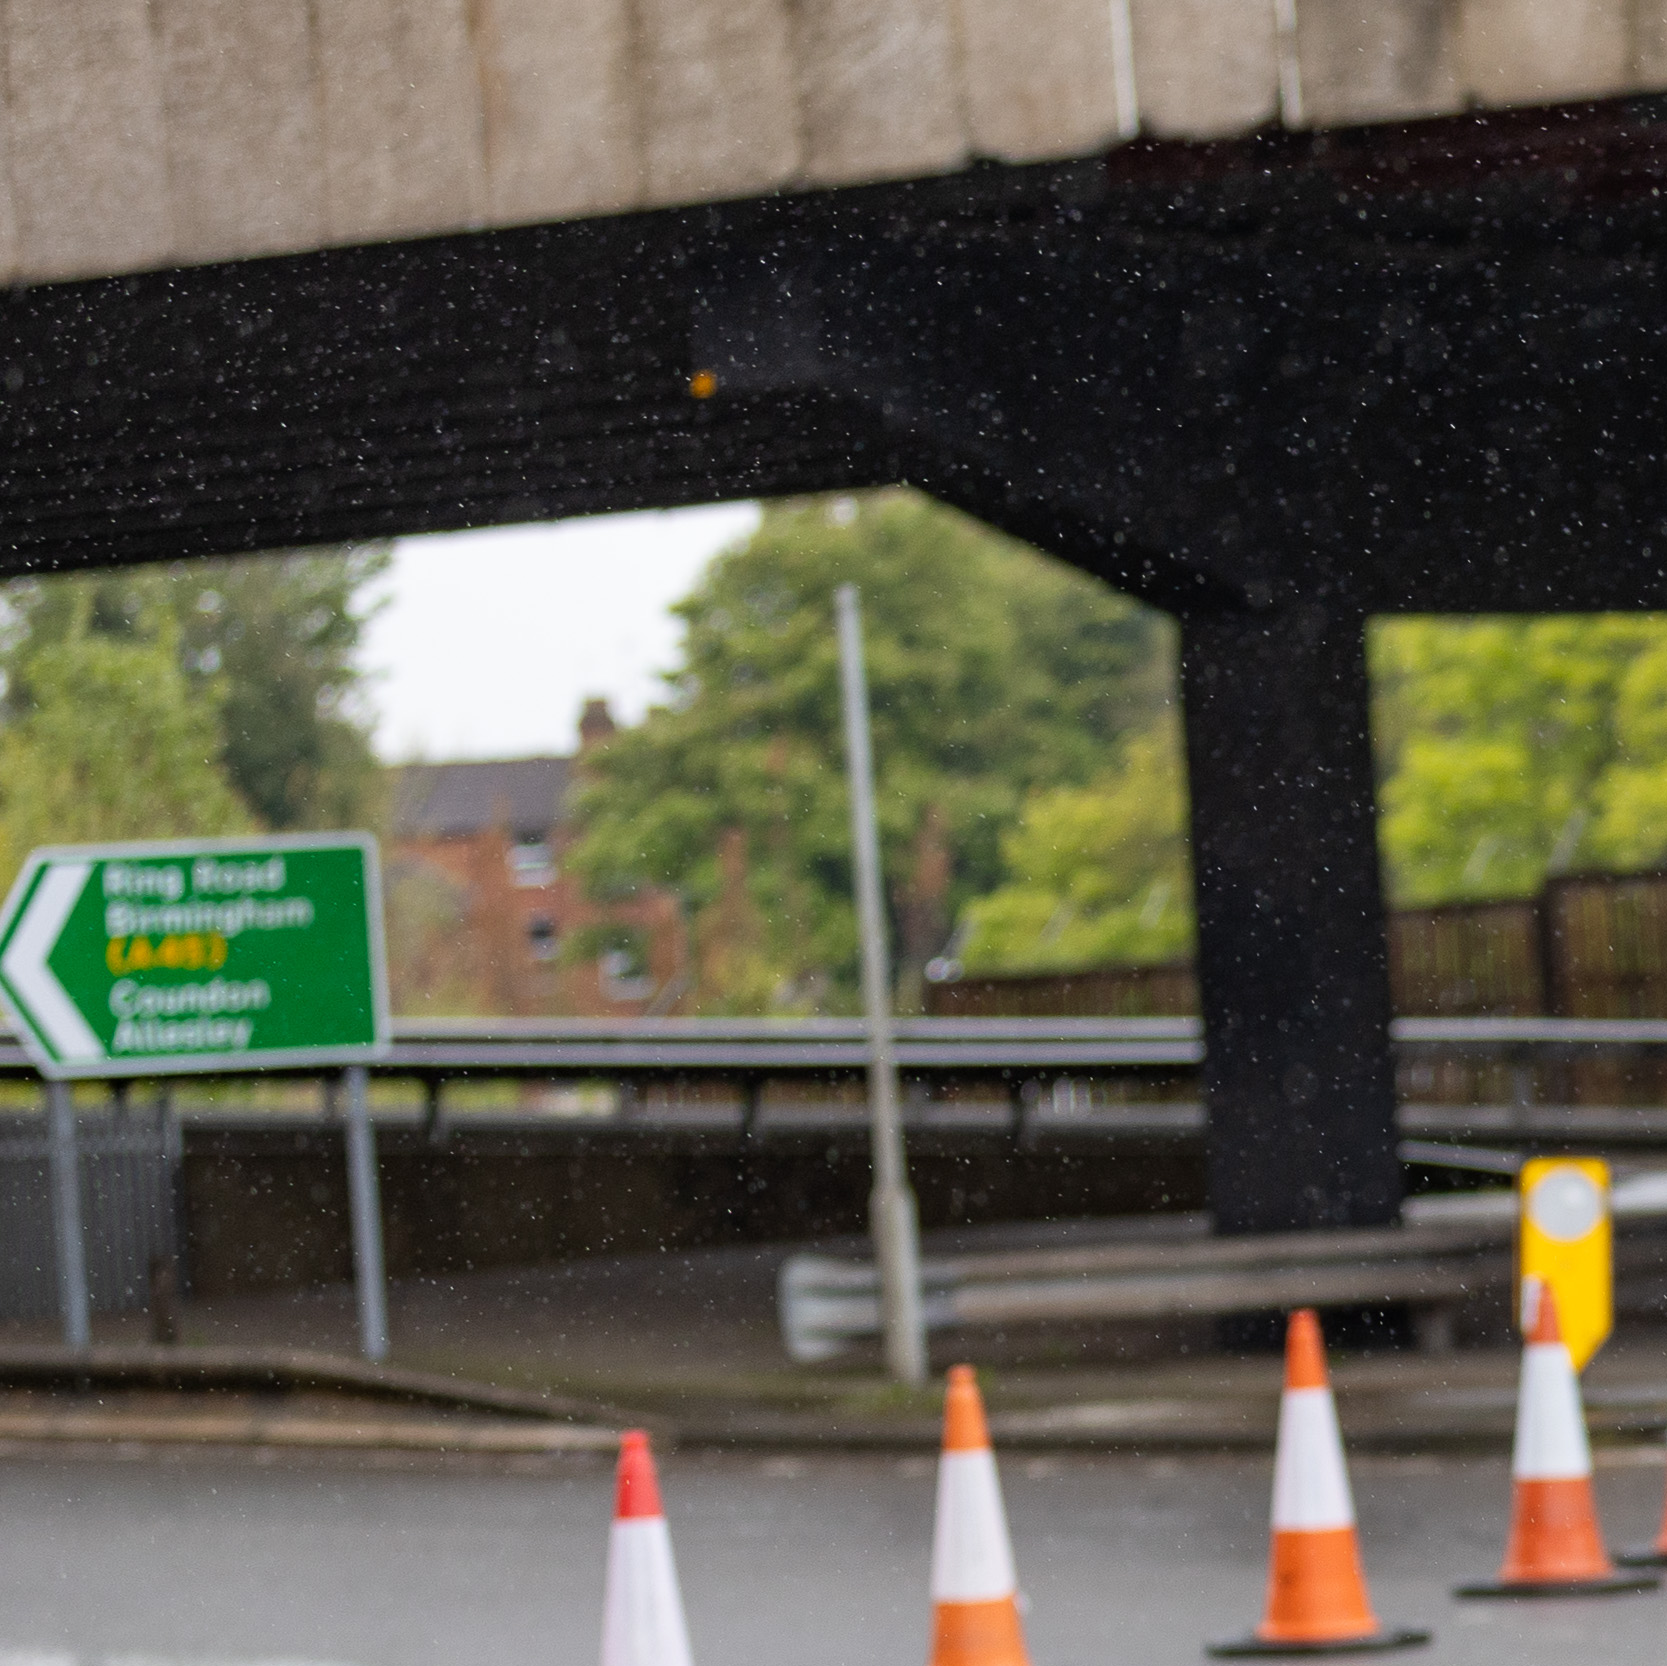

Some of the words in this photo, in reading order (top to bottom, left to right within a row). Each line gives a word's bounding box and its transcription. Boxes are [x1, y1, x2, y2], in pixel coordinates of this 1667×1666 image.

[103, 862, 185, 901] Ring
[192, 856, 287, 894] Road
[105, 897, 314, 937] Birmingham
